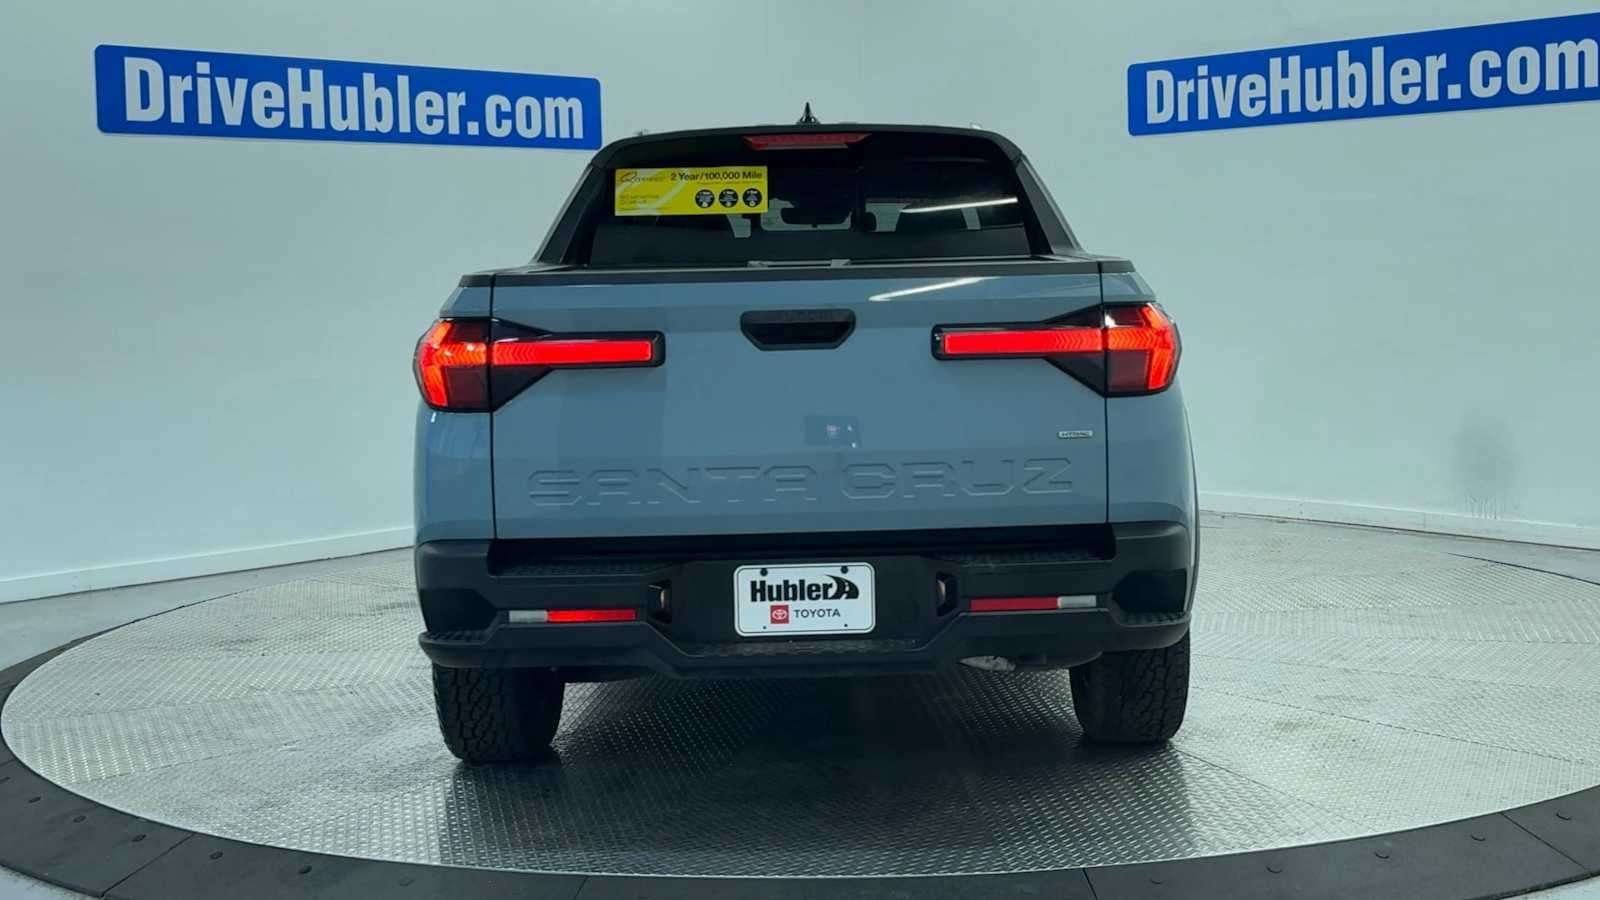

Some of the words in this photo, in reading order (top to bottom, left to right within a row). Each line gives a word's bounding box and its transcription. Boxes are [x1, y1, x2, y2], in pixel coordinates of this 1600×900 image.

[124, 56, 584, 139] DriveHubler.com
[1146, 37, 1599, 124] DriveHubler.com
[670, 173, 678, 181] 2
[680, 171, 740, 182] Year/100,000
[742, 171, 763, 180] Mile
[528, 464, 817, 505] SANTA
[840, 457, 1073, 500] CRUZ
[750, 579, 833, 602] Hubler
[793, 608, 841, 618] TOYOTA
